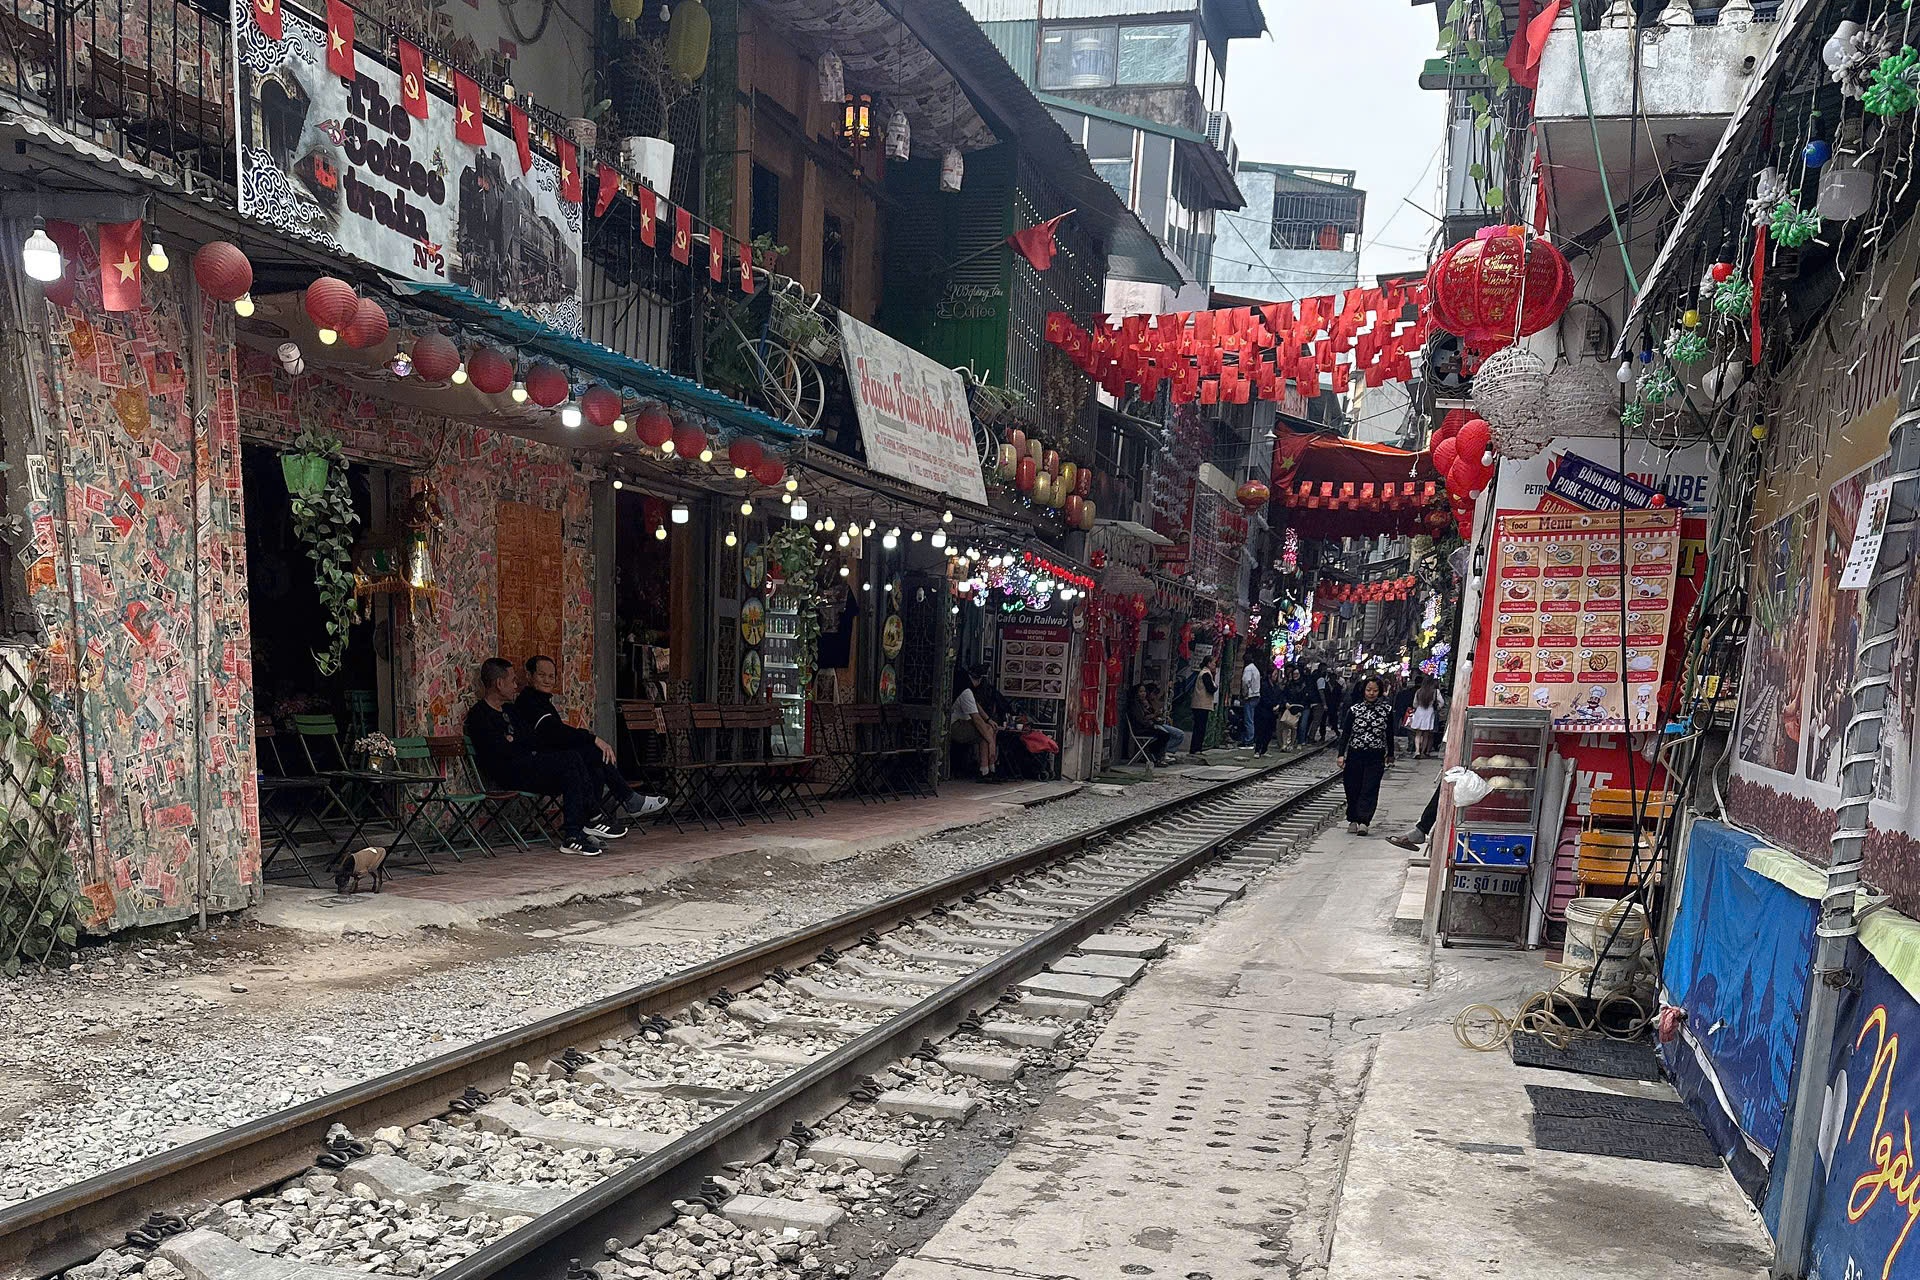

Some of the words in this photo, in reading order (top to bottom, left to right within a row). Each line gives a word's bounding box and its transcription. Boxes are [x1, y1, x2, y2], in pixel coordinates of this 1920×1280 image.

[341, 73, 411, 142] The
[342, 115, 446, 205] Coffee
[342, 166, 430, 243] train
[952, 301, 996, 319] Coffee
[857, 356, 897, 415] Hanoi
[892, 371, 922, 427] Train
[920, 386, 951, 438] Street
[1554, 476, 1610, 511] PORK-FILLED
[1601, 477, 1620, 495] BAO
[1511, 521, 1528, 530] food
[1538, 516, 1573, 530] Menu
[997, 613, 1016, 623] Café
[1018, 614, 1031, 624] On
[1033, 615, 1068, 627] Railway
[1474, 875, 1491, 890] SỐ
[1493, 879, 1498, 892] 1
